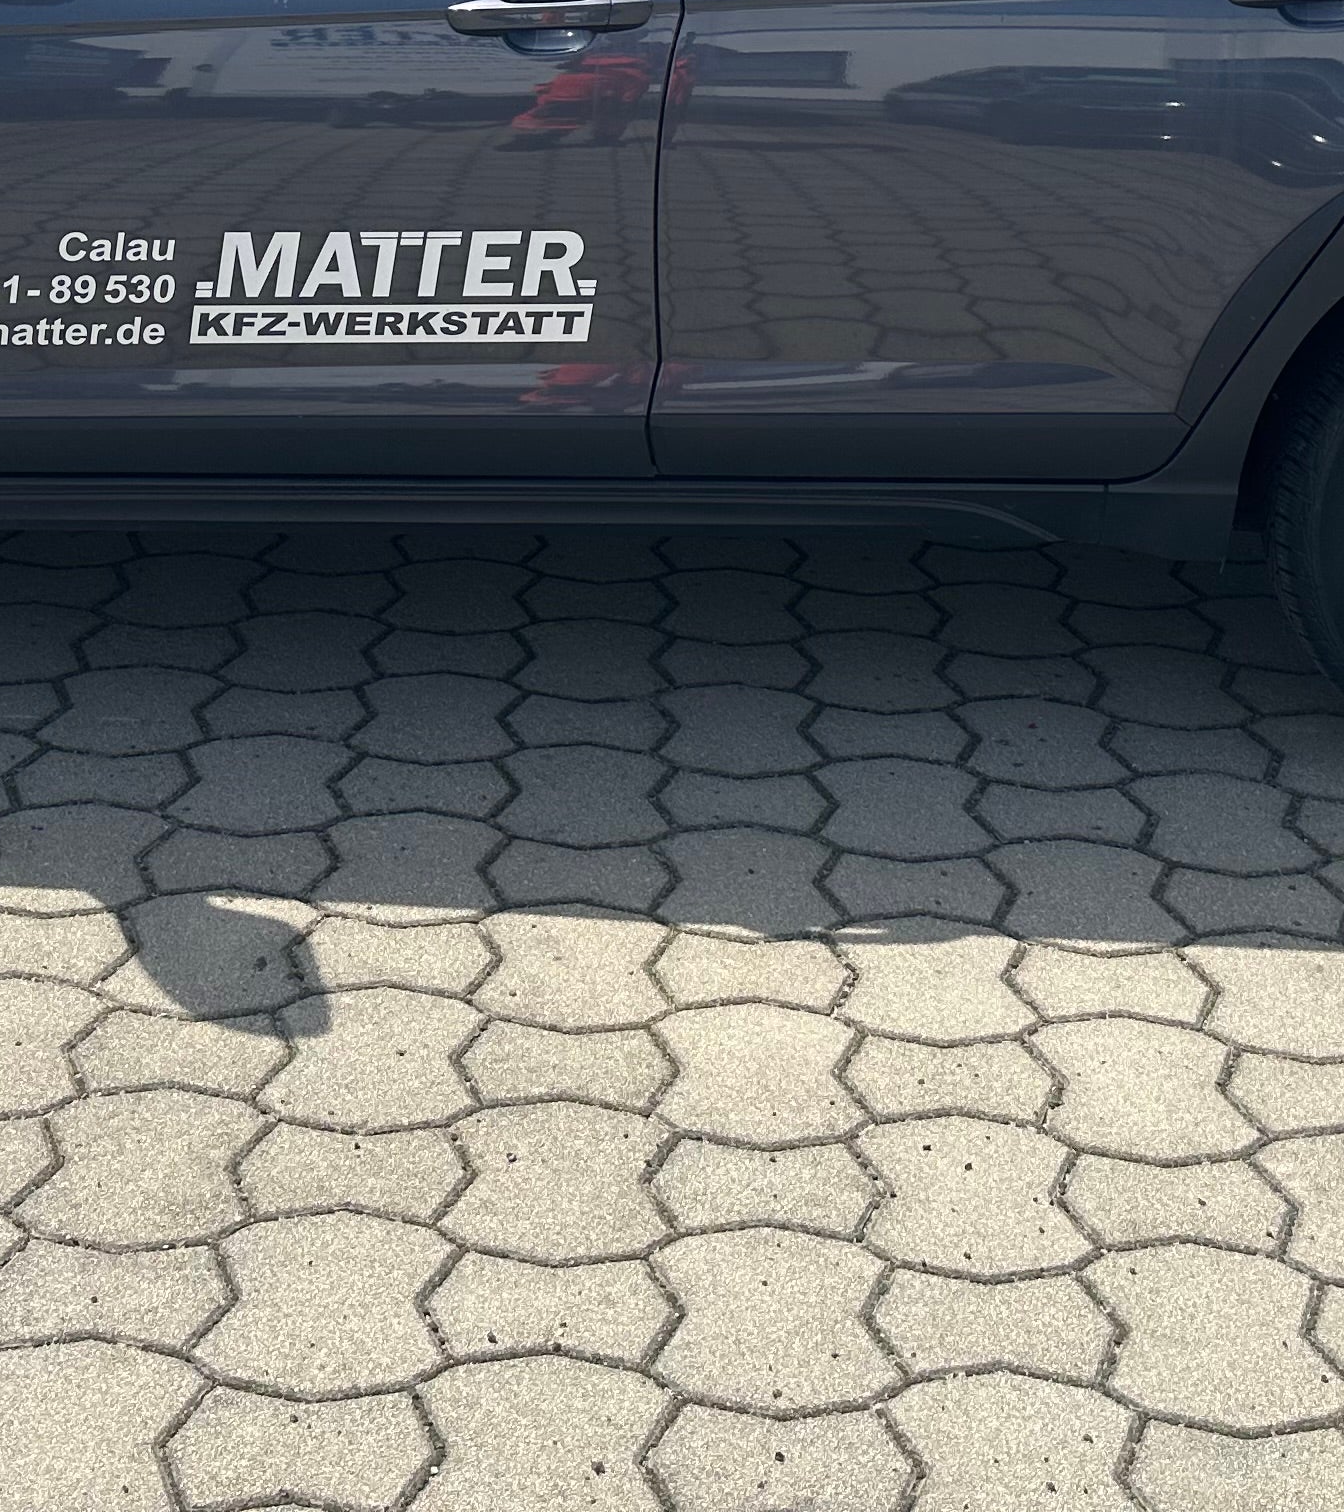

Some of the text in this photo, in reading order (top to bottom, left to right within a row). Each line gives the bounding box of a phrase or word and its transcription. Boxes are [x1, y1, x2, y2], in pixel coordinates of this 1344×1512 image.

[58, 232, 176, 262] Calau
[195, 230, 597, 299] MATTER
[197, 311, 585, 337] KFZ-WERKSTATT
